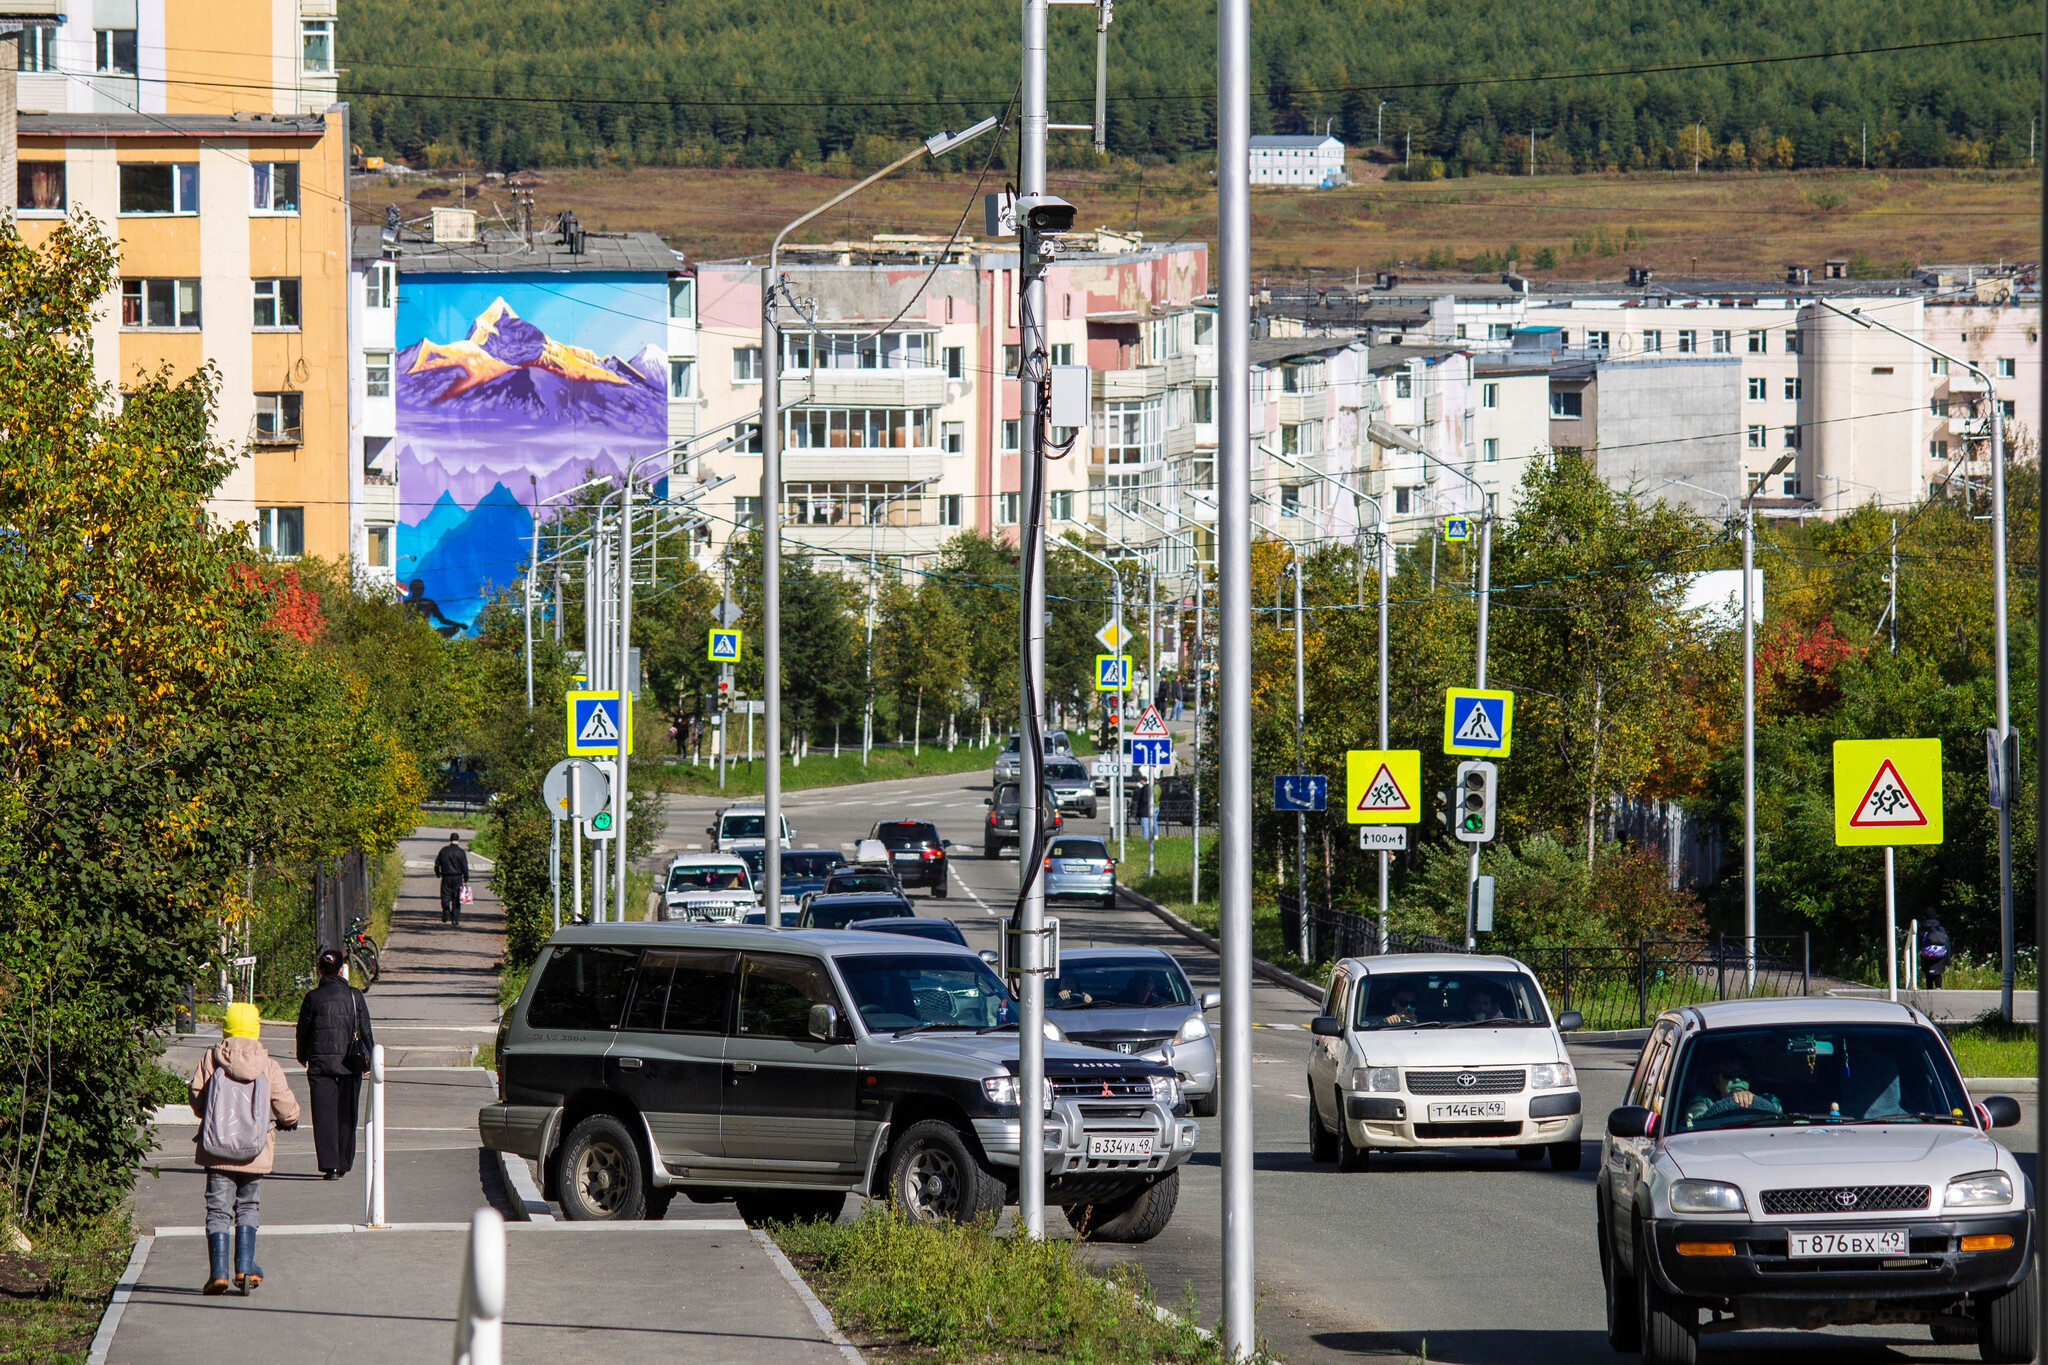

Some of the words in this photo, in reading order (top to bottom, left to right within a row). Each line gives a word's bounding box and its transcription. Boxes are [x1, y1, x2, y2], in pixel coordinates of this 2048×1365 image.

[1436, 1104, 1485, 1117] Т144ЕК
[1488, 1103, 1501, 1112] 49
[1095, 1140, 1135, 1153] В334УА
[1139, 1139, 1150, 1148] 49
[1798, 1234, 1875, 1253] Т876ВХ
[1881, 1232, 1900, 1247] 49
